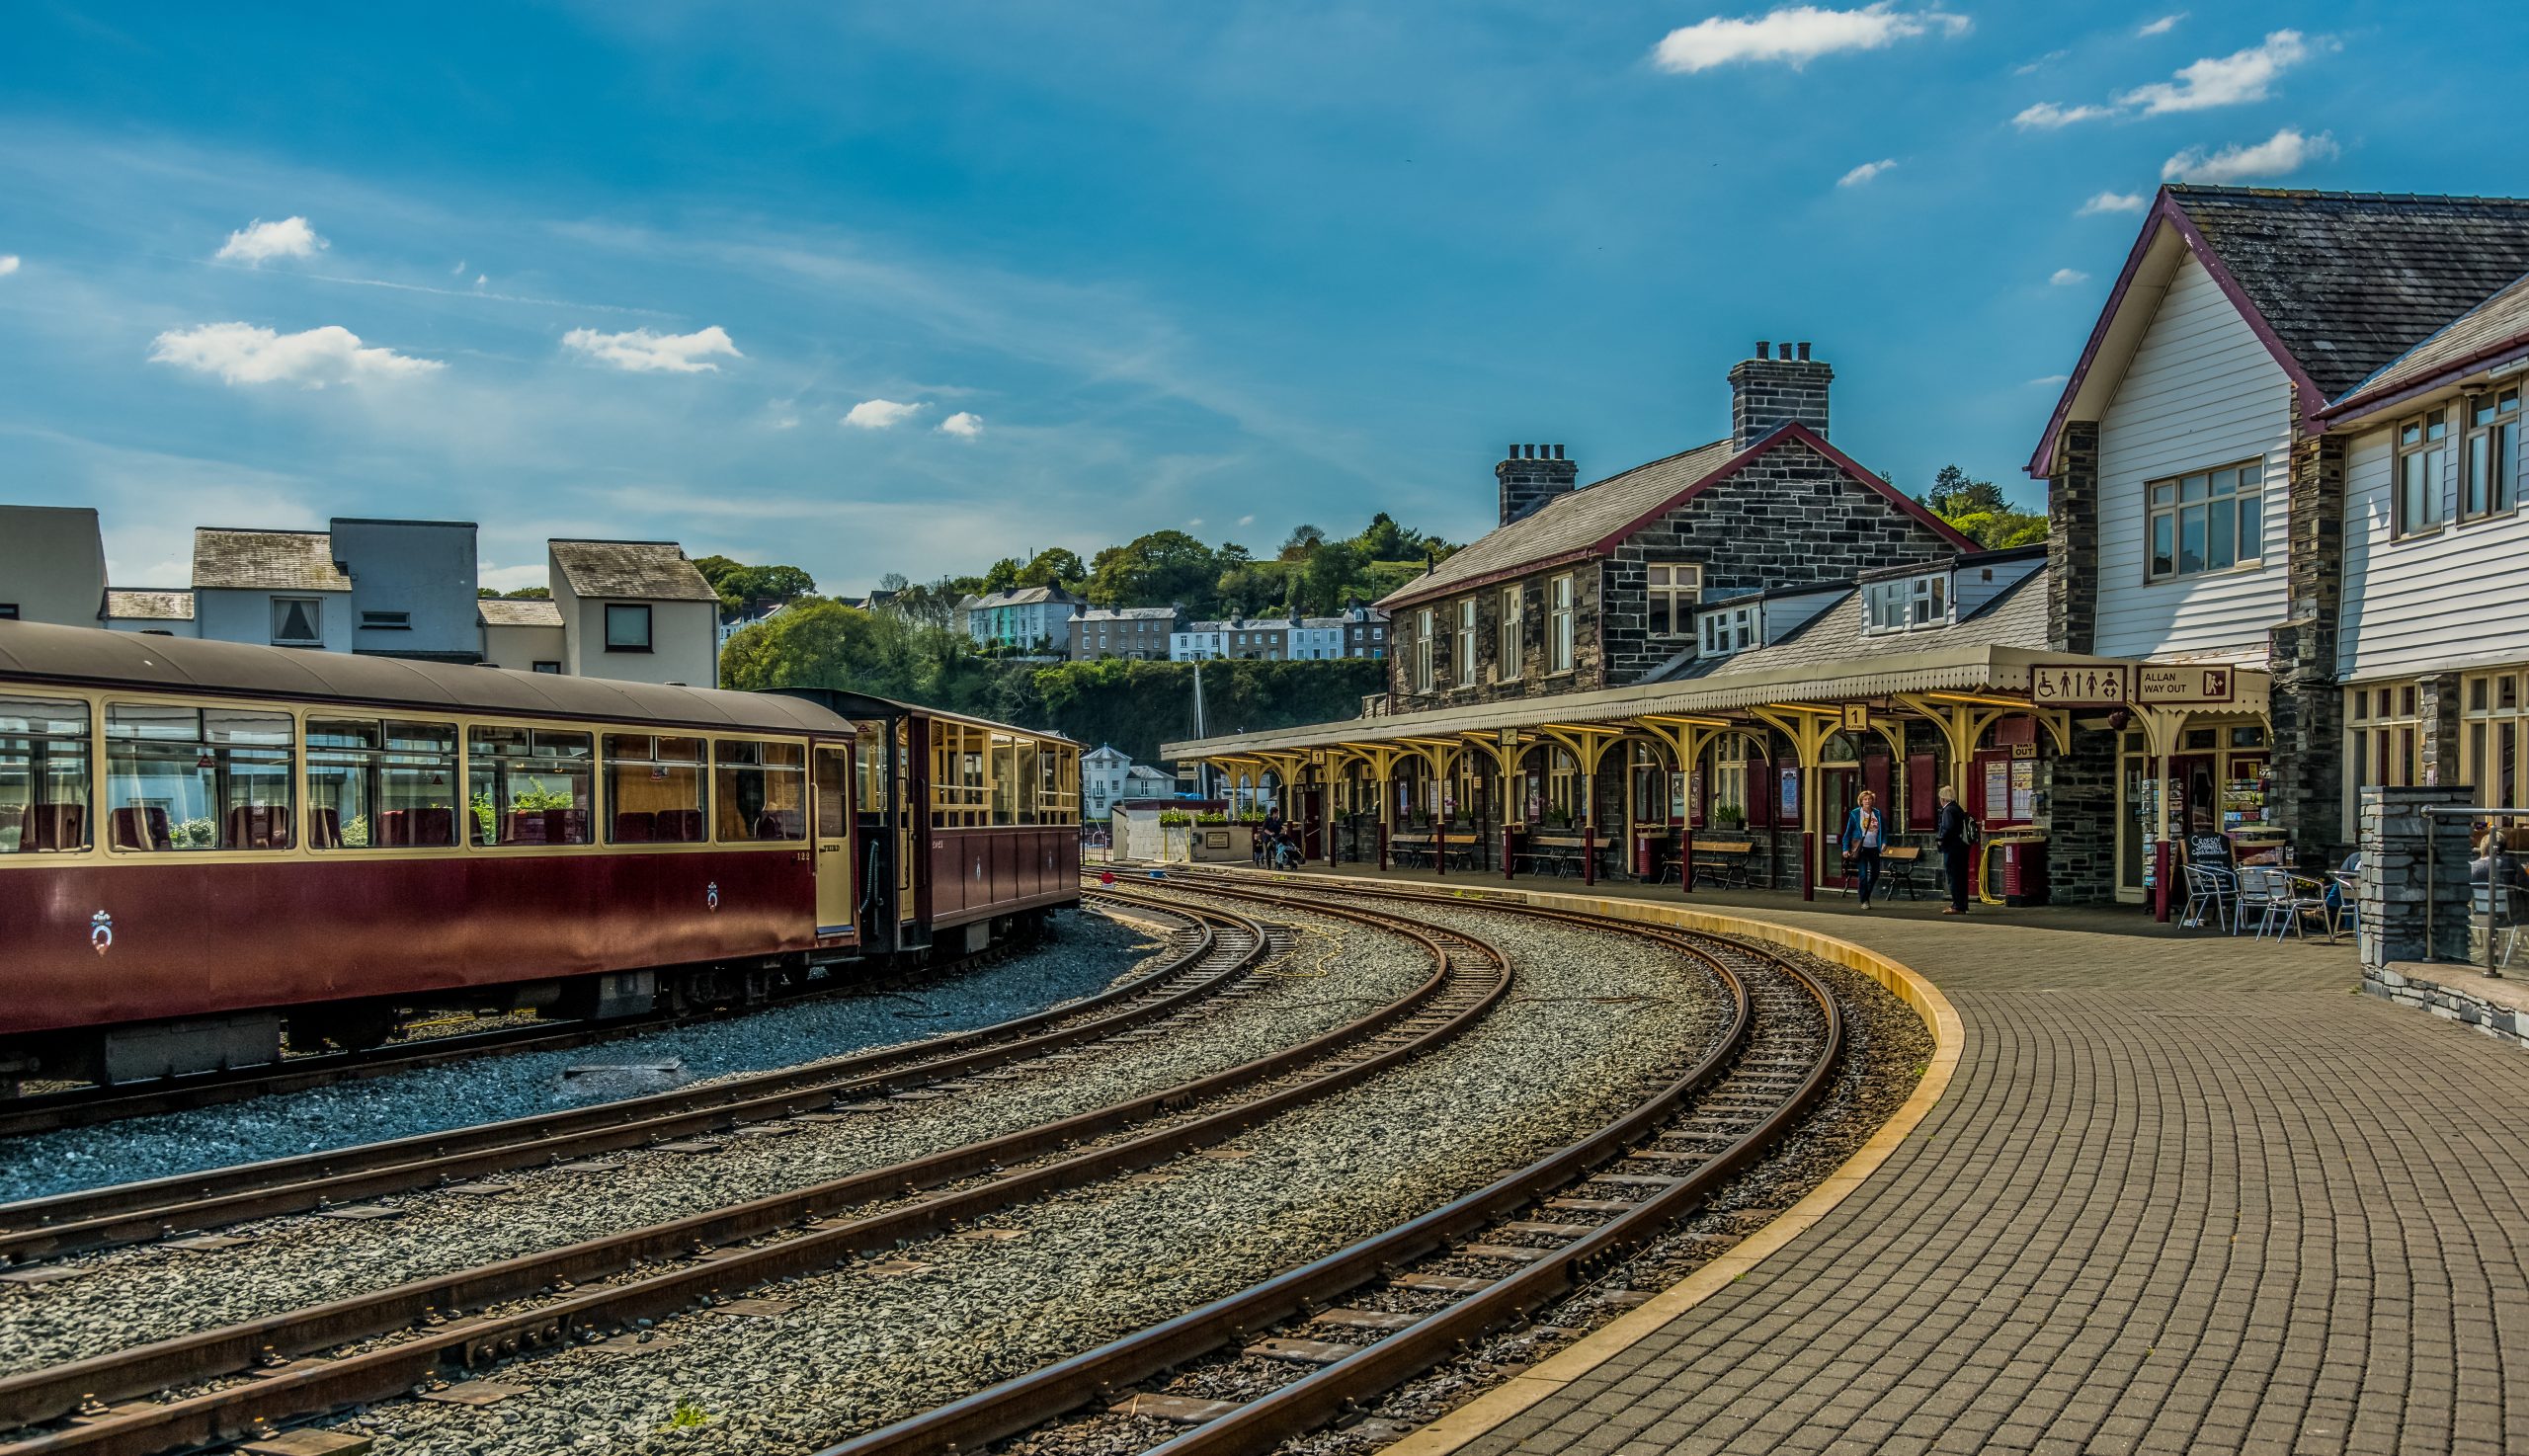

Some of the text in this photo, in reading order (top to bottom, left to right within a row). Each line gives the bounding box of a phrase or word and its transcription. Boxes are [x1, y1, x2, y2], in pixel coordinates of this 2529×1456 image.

[2145, 673, 2176, 682] ALLAN
[2145, 684, 2186, 693] WAY OUT
[1851, 709, 1858, 724] 1
[1315, 753, 1320, 762] 1
[797, 851, 810, 860] 122
